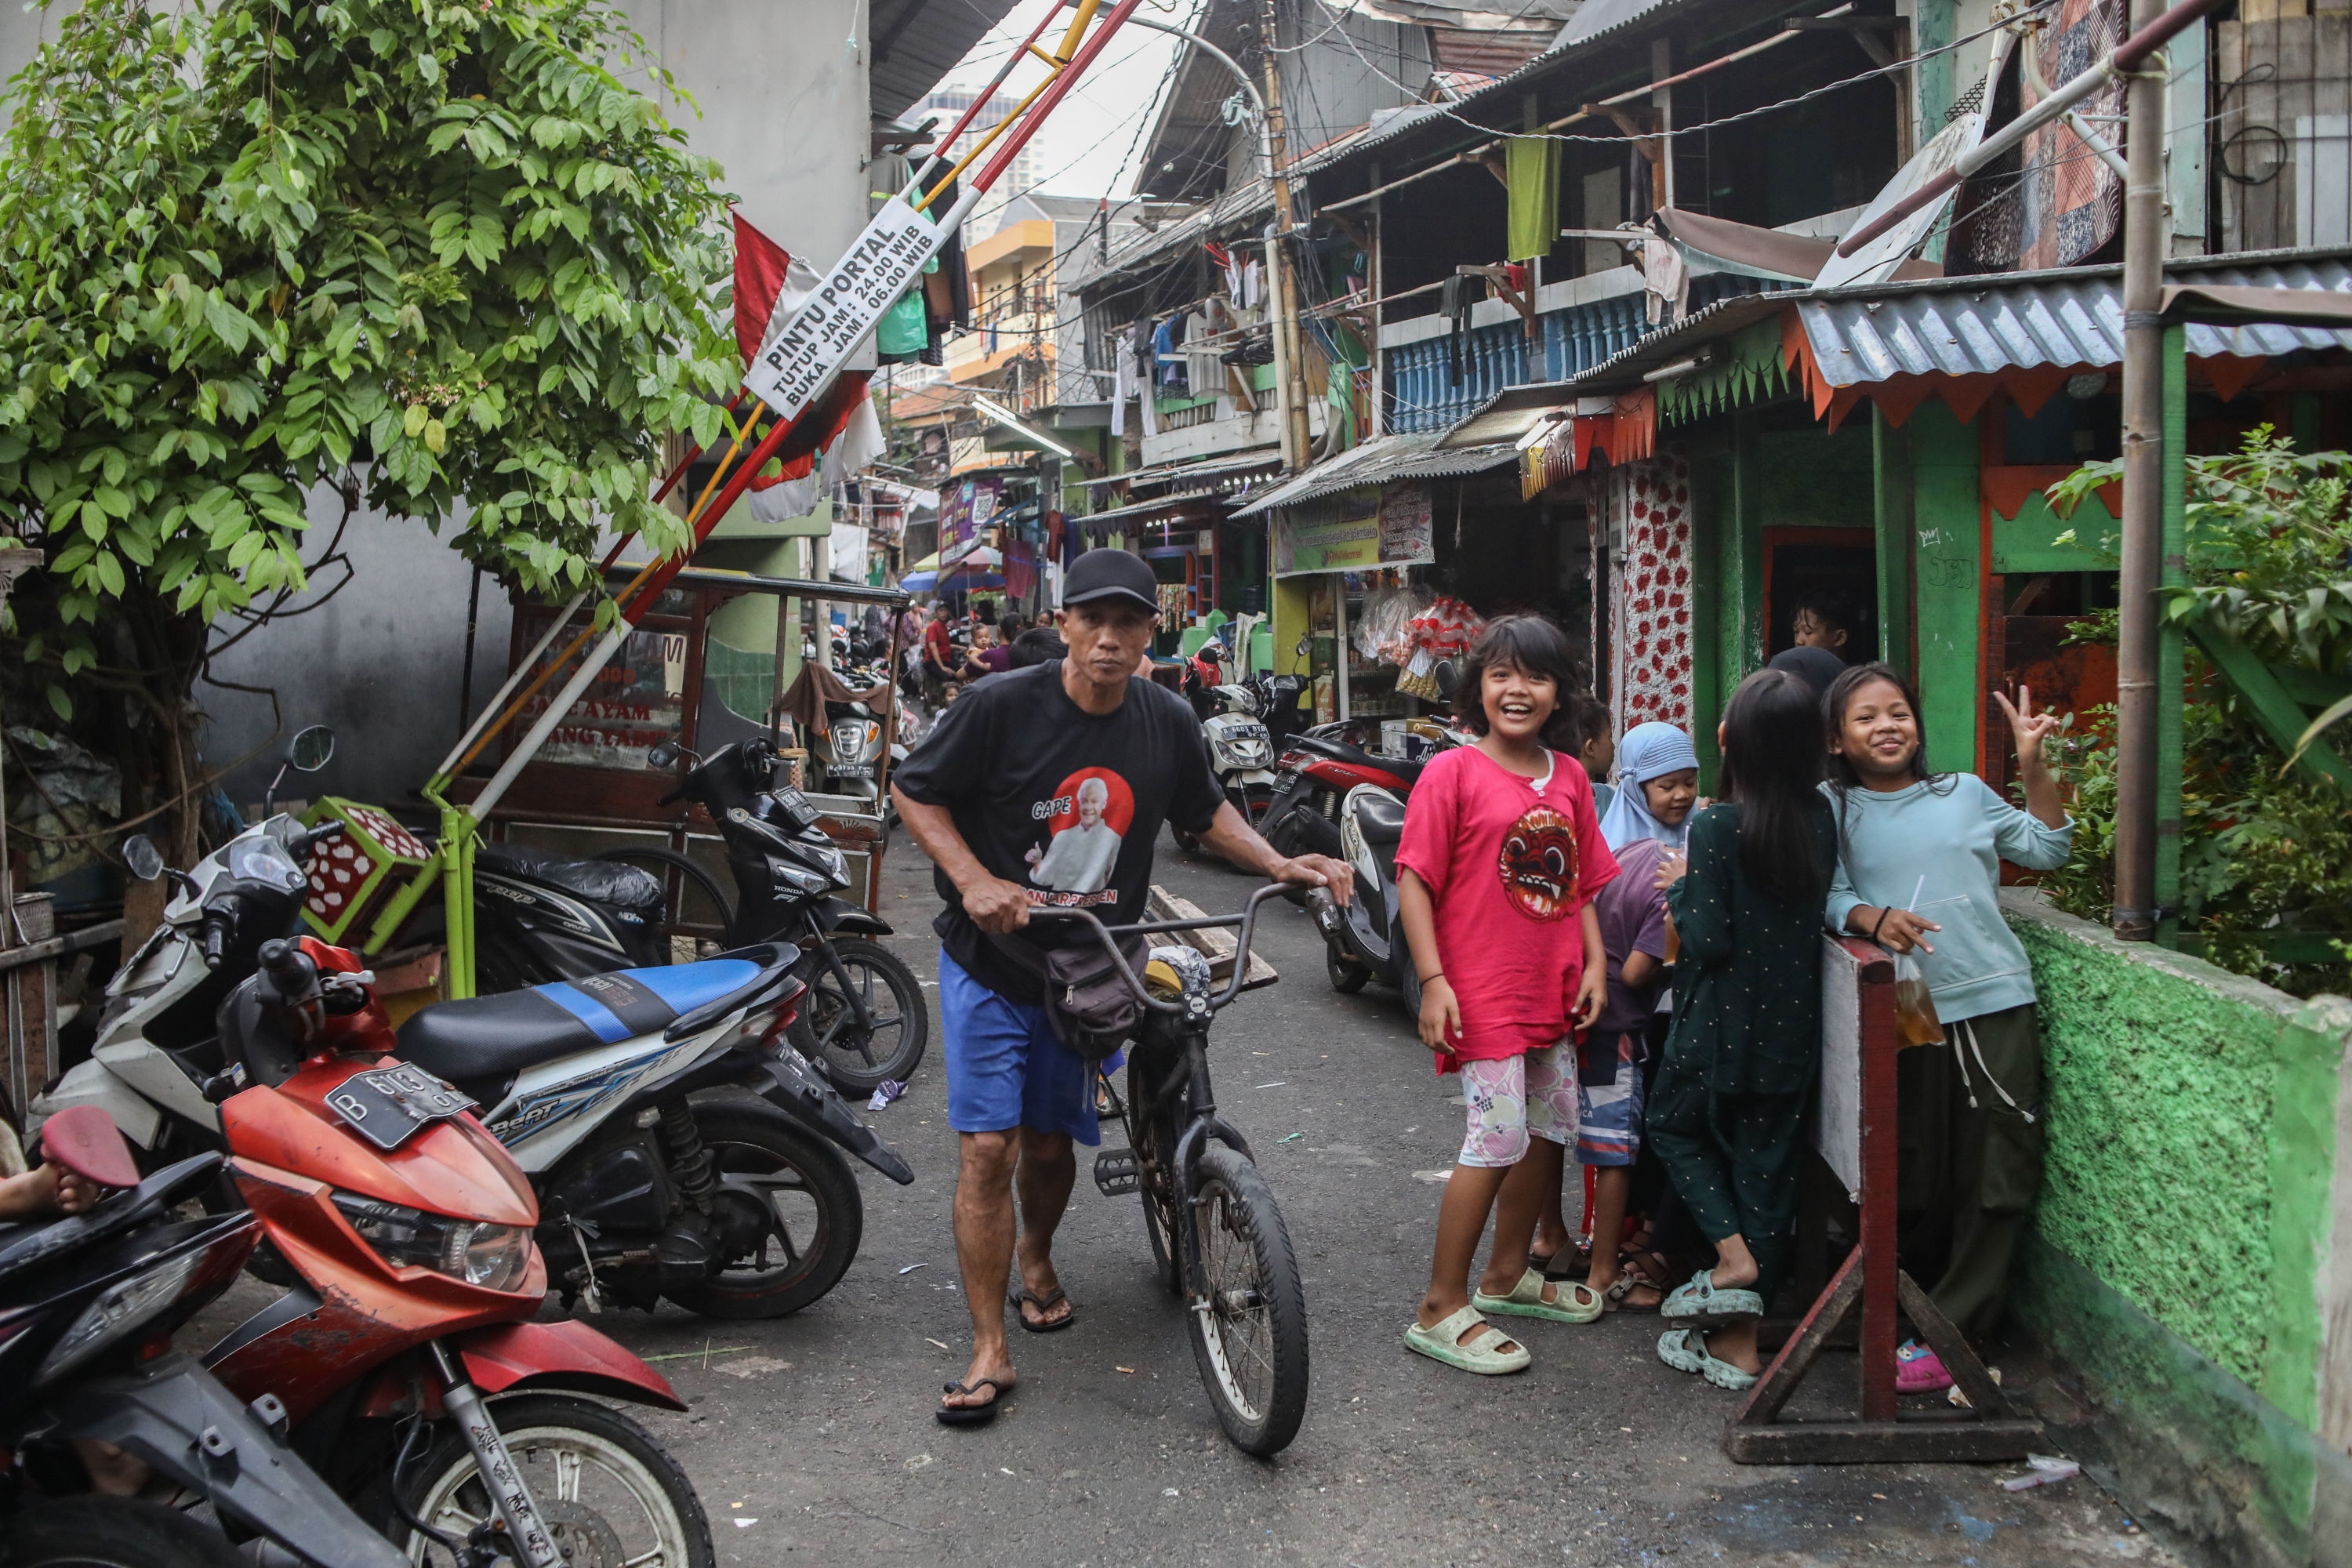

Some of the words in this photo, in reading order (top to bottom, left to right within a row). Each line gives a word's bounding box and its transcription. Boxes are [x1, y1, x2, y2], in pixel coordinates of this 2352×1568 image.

[766, 303, 826, 372] PINTU
[820, 227, 896, 307] PORTAL
[772, 342, 818, 394] TUTUP
[855, 256, 894, 301] 24.00
[889, 224, 920, 257] WIB
[786, 361, 828, 407] BUKA
[868, 267, 906, 310] 06.00
[902, 235, 934, 269] WIB
[522, 696, 579, 717] SAE
[583, 700, 650, 721] AYAM
[1032, 796, 1071, 819] GAPE
[335, 1094, 368, 1122] B
